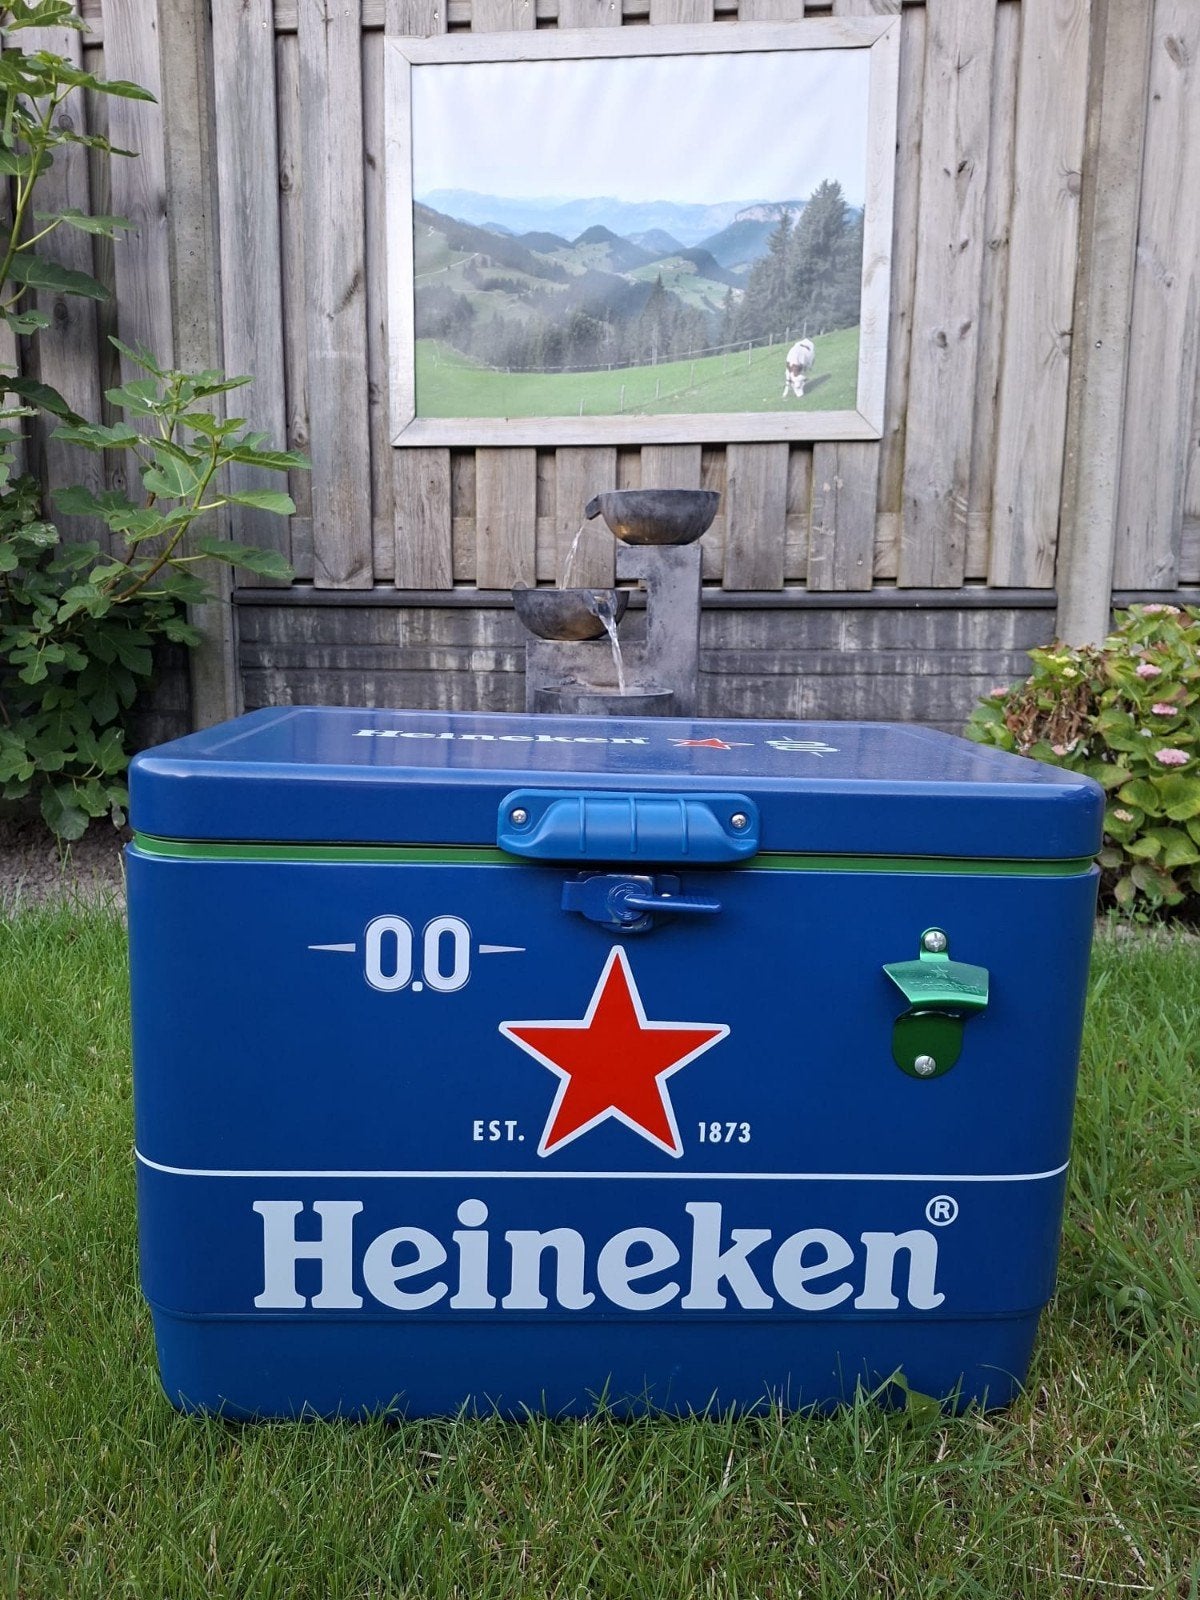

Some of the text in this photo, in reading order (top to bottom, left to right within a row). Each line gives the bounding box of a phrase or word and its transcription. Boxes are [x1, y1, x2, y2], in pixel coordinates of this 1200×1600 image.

[353, 729, 649, 745] Heineken
[364, 913, 471, 993] 0.0
[473, 1120, 751, 1144] EST. 1873
